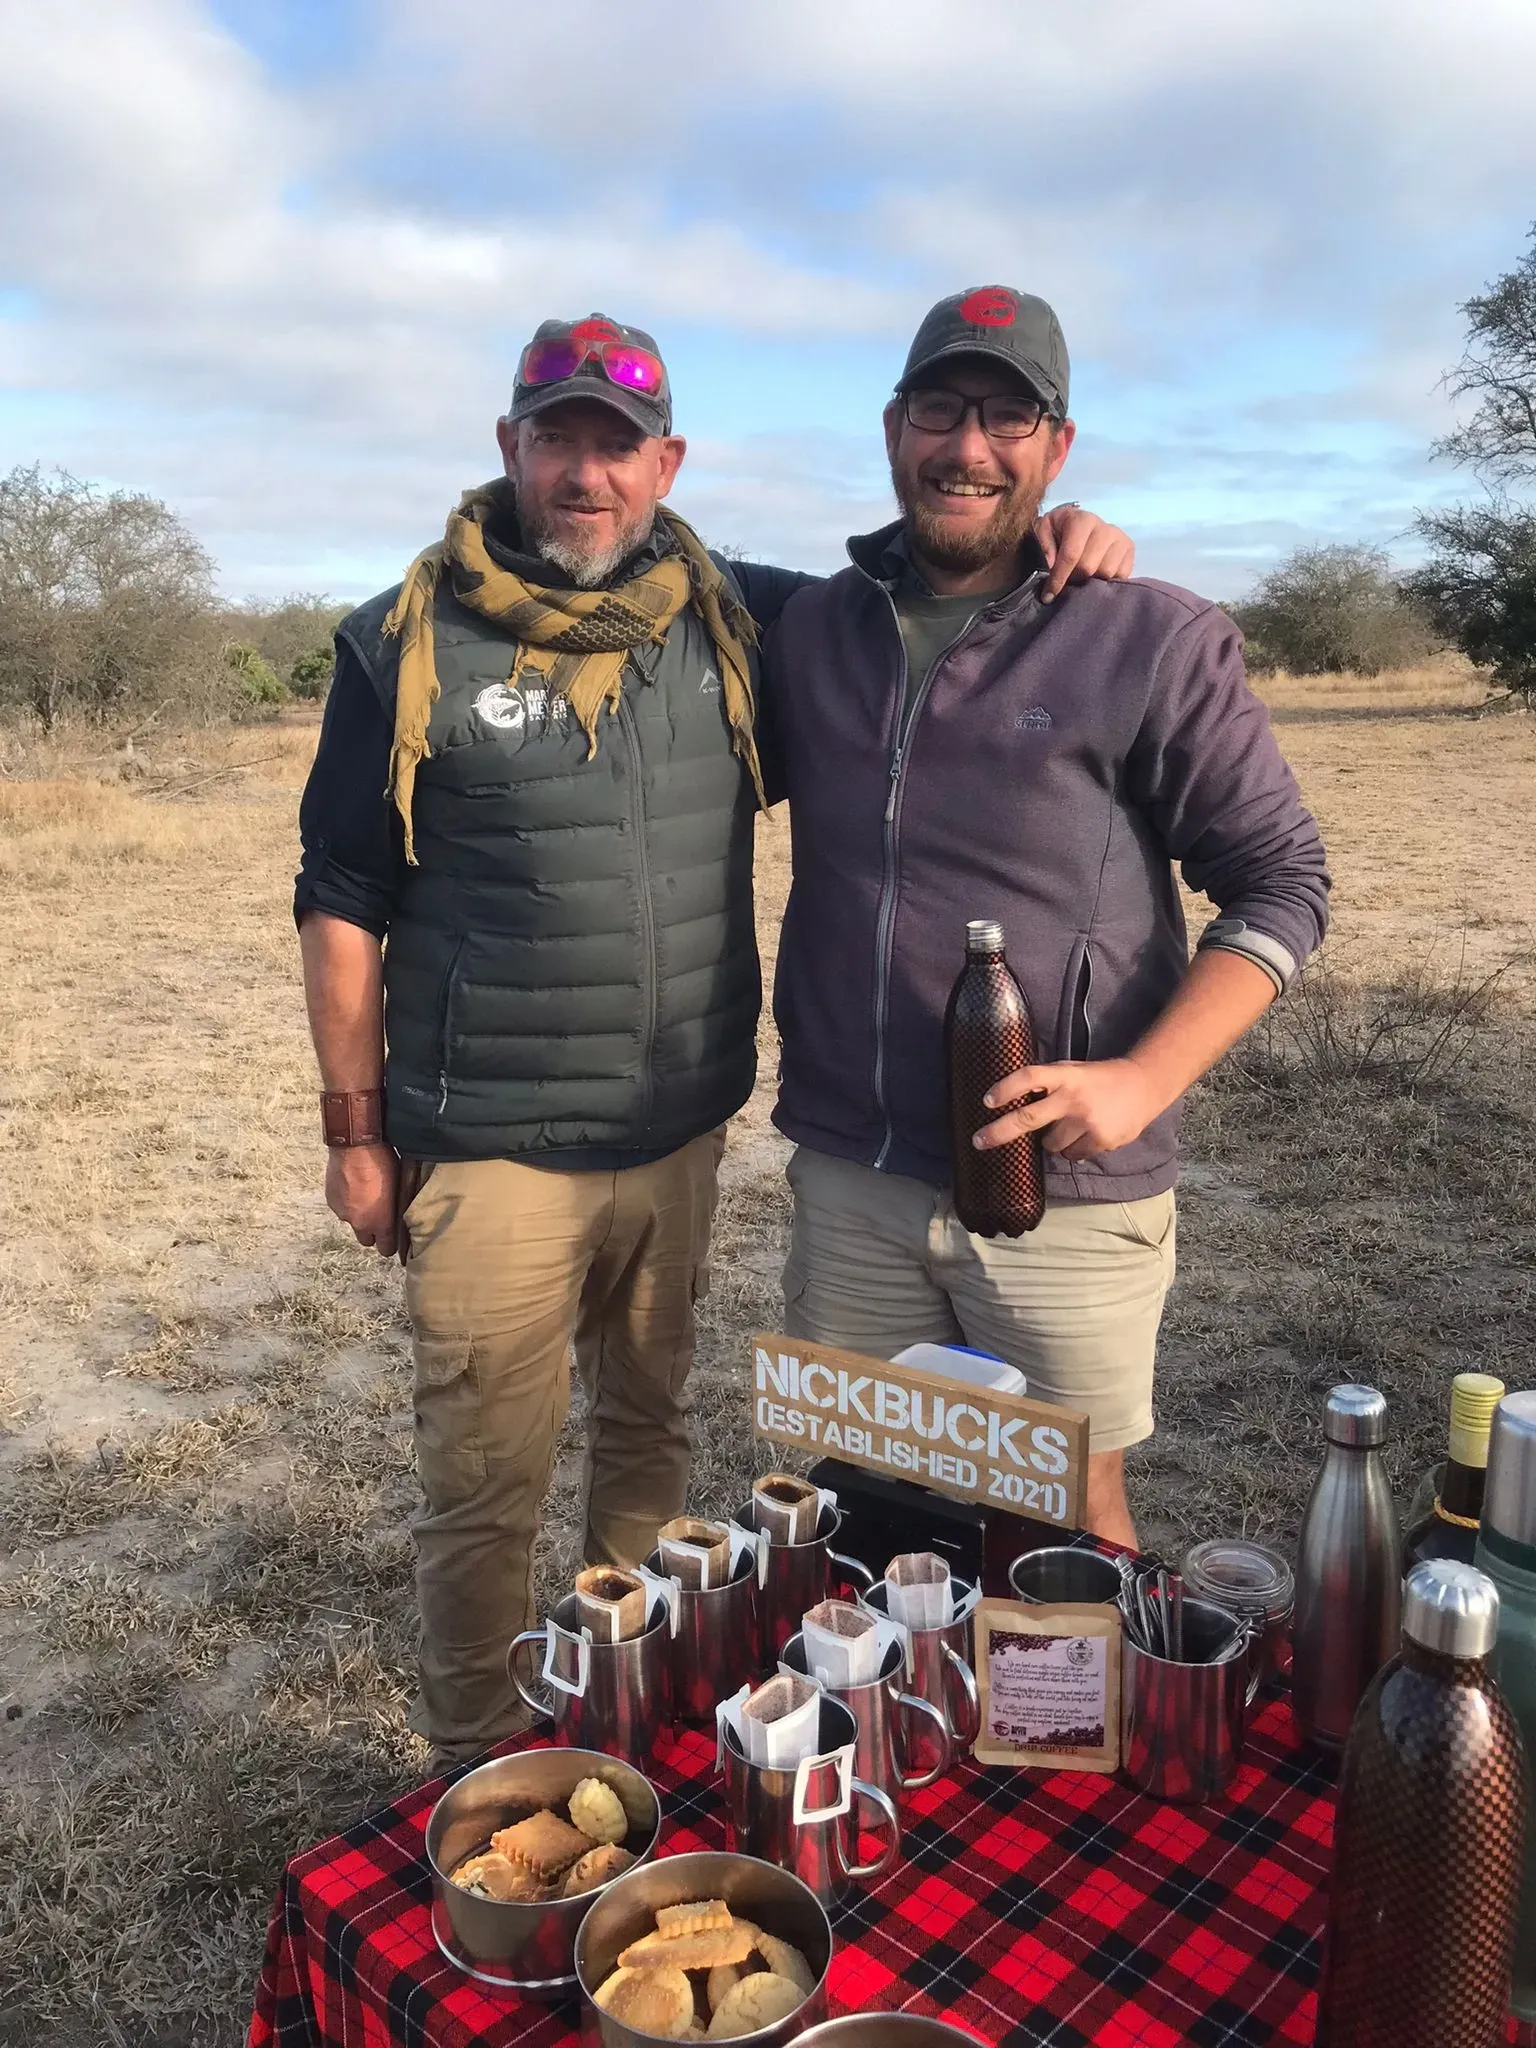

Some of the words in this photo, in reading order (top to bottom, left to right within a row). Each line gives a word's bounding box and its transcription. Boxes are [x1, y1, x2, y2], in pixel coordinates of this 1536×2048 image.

[755, 1347, 1069, 1475] NICKBUCKS
[757, 1396, 978, 1489] (ESTABLISHED
[988, 1467, 1067, 1521] 2021)
